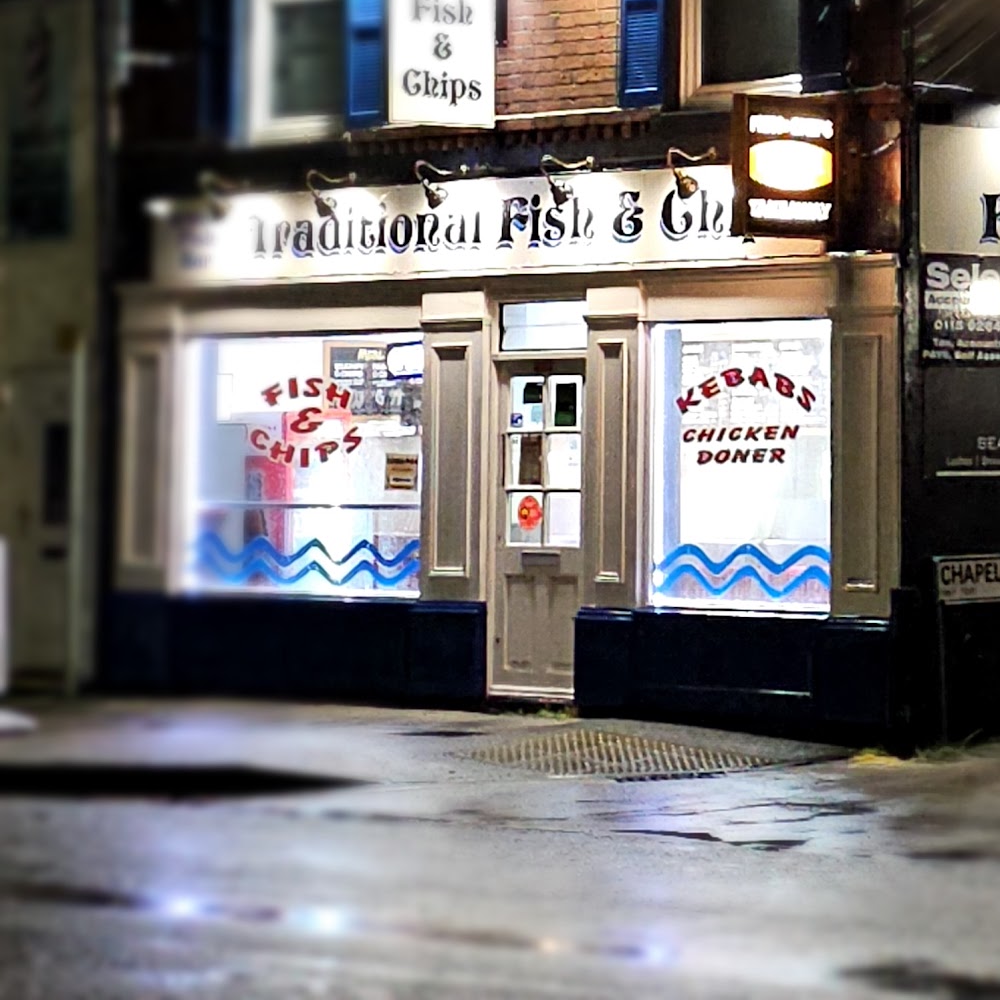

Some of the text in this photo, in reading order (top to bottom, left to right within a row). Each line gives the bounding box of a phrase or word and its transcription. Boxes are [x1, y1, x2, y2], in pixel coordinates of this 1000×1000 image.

[433, 33, 453, 60] &
[402, 68, 483, 107] Chips
[496, 193, 595, 249] Fish
[611, 191, 644, 243] &
[261, 377, 350, 408] FISH
[676, 367, 816, 414] KEBABS
[290, 407, 323, 434] &
[683, 425, 800, 442] CHICKEN
[251, 426, 362, 468] CHIPS
[697, 448, 786, 465] DONER
